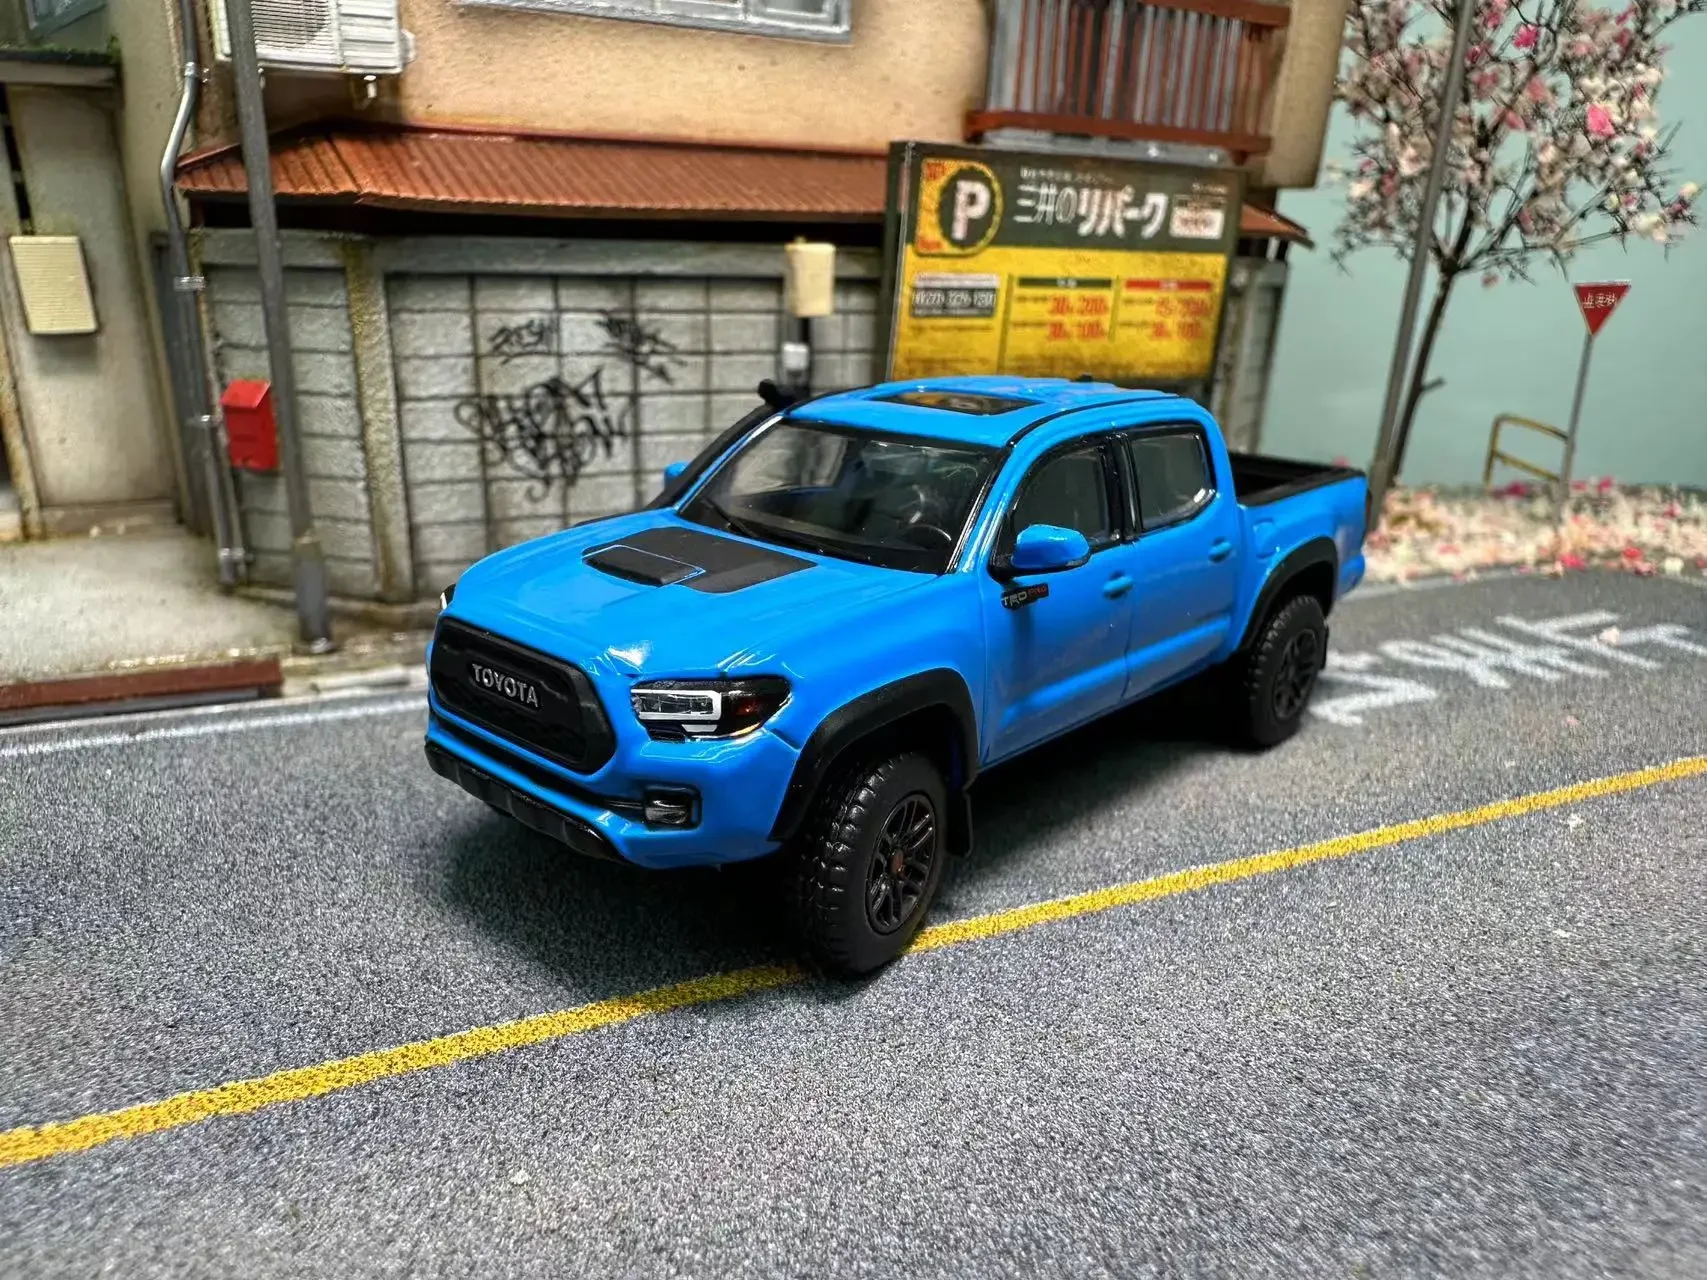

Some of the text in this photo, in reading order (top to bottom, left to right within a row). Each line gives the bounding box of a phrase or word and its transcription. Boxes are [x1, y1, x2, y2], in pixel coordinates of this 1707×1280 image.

[951, 180, 991, 241] P
[1013, 182, 1169, 239] 三井のリパーク
[1001, 591, 1028, 607] TRD
[472, 663, 539, 708] TOYOTA
